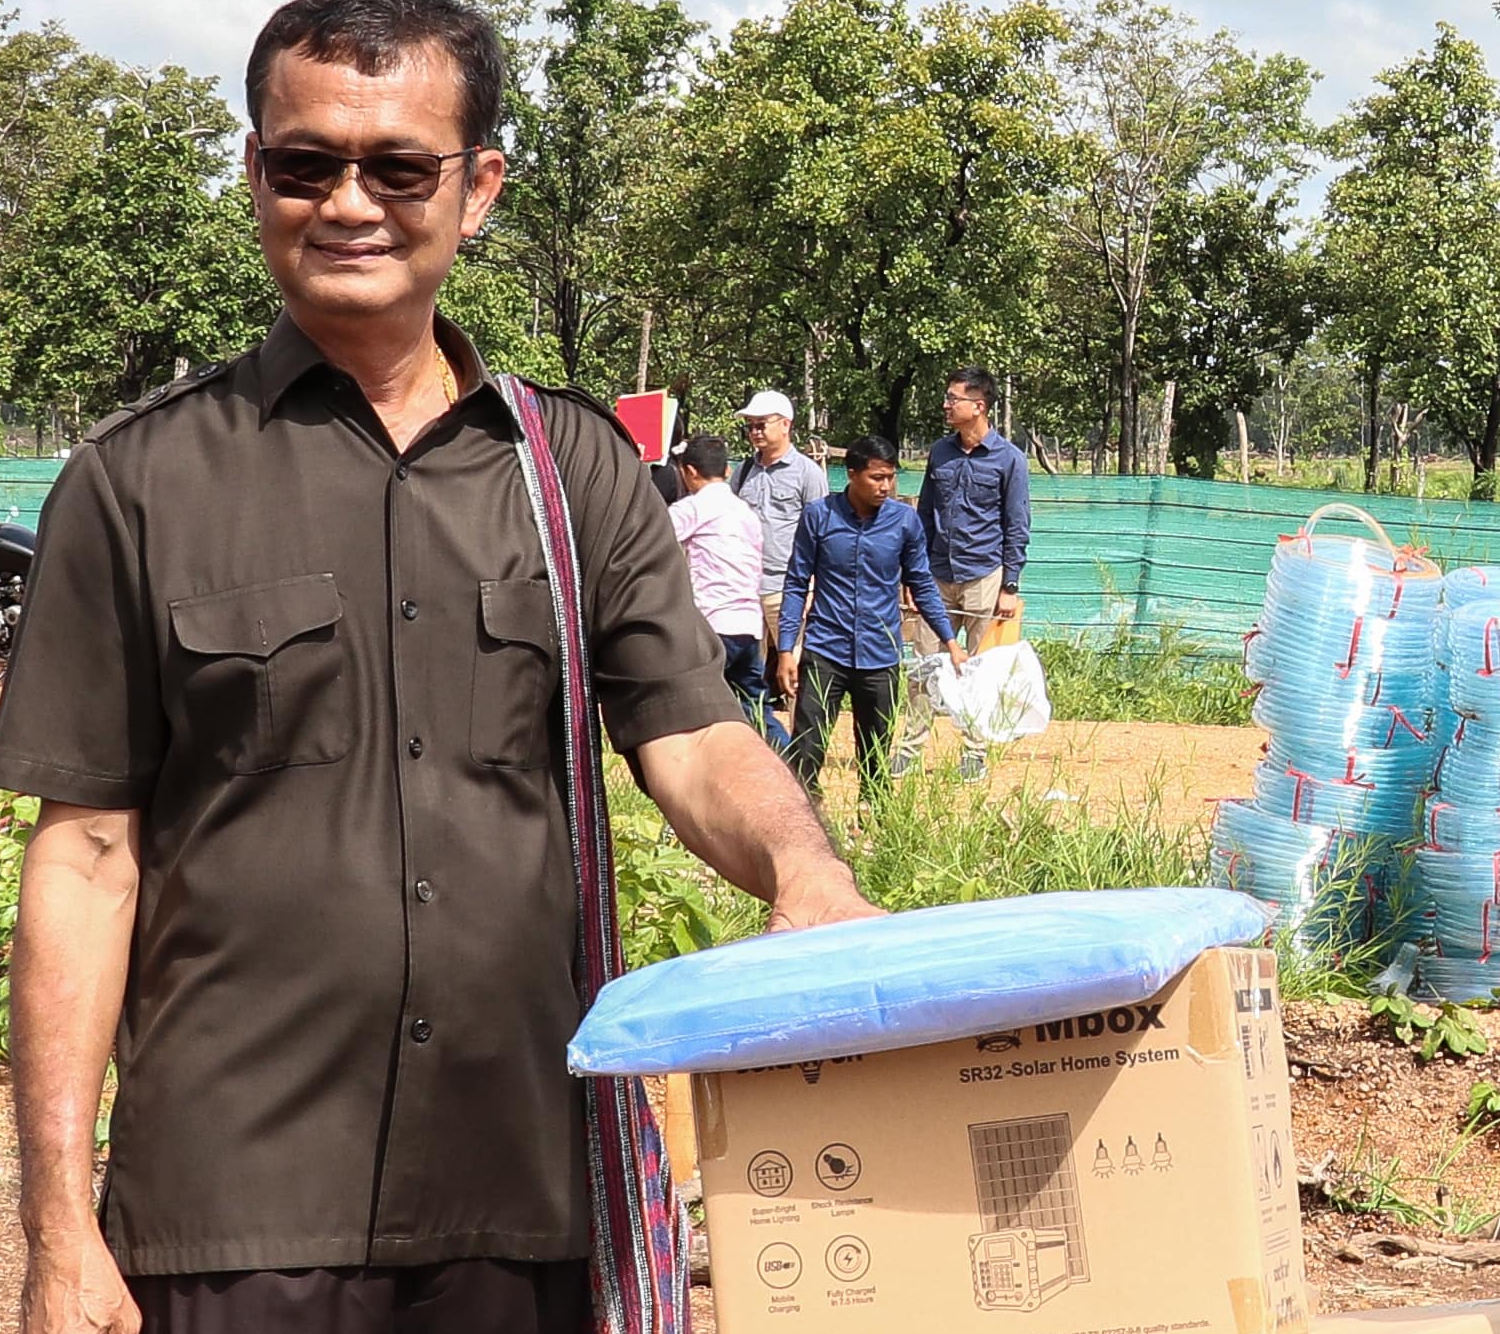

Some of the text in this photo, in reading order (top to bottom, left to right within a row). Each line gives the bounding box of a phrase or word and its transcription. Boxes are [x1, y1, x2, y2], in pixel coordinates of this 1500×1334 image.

[959, 1066, 1003, 1083] SR32
[1061, 1054, 1110, 1072] Home
[1115, 1048, 1180, 1067] System
